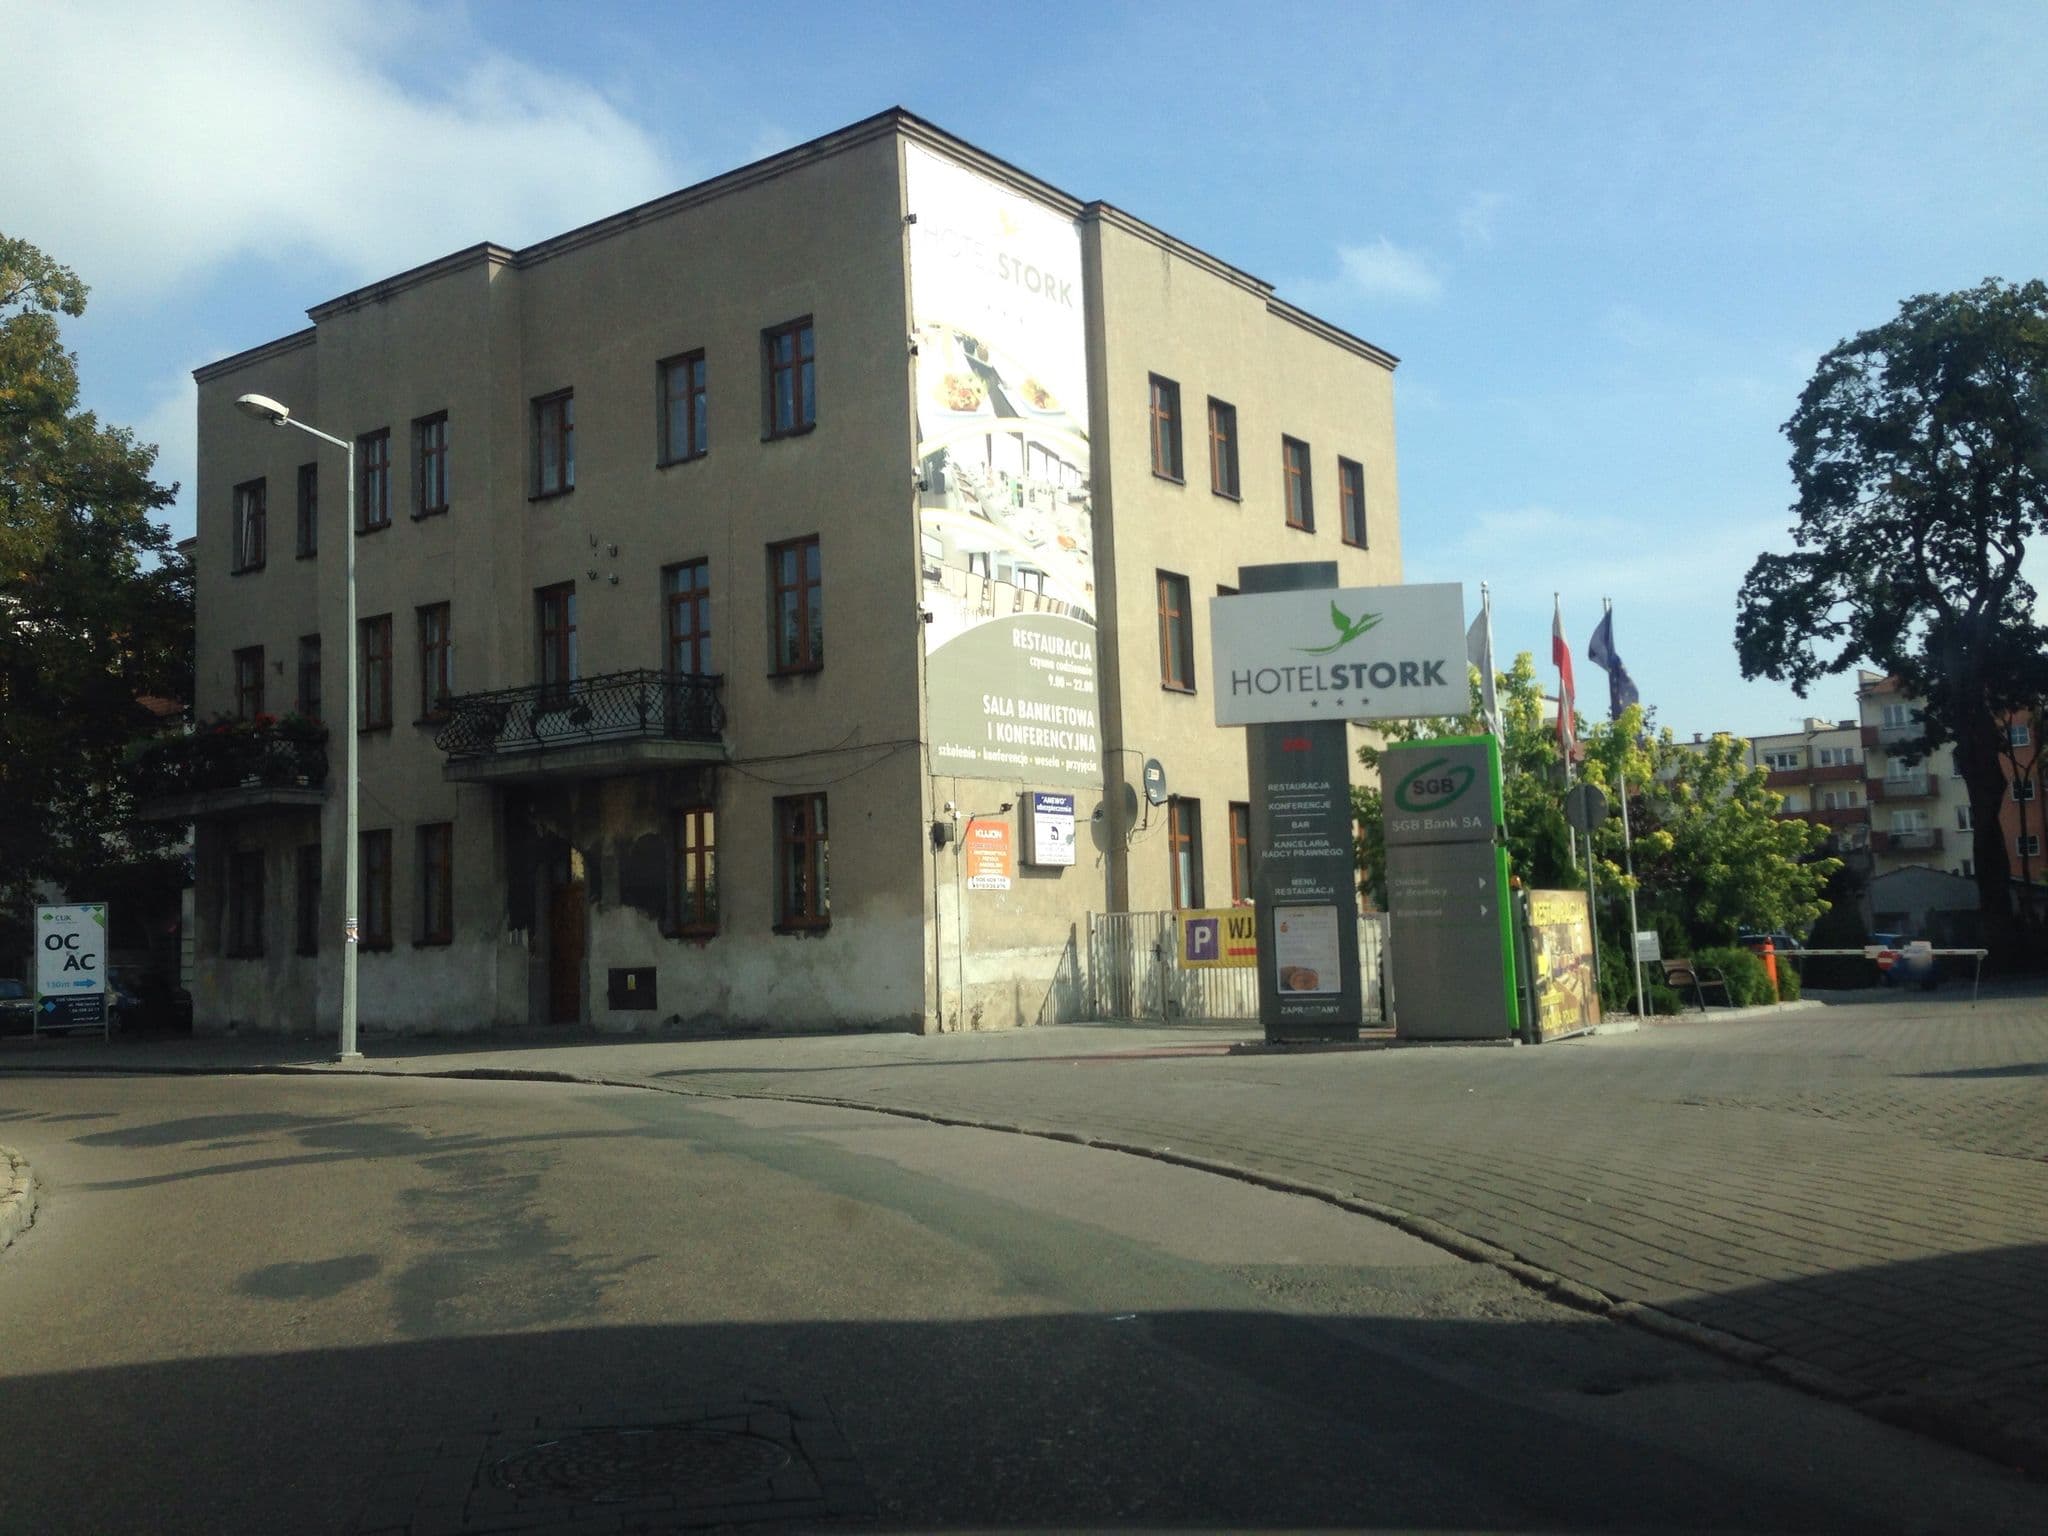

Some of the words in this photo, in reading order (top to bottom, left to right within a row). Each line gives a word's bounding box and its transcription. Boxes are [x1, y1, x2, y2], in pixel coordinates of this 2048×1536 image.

[998, 252, 1073, 308] STORK
[1012, 628, 1092, 661] RESTAURACJA
[982, 694, 1015, 717] SALA
[1018, 700, 1095, 728] BANKIETOWA
[988, 721, 992, 740] I
[996, 724, 1096, 753] KONFERENCYJNA
[983, 747, 1028, 766] konferencje
[1034, 755, 1060, 768] wesela
[1267, 782, 1330, 791] RESTAURACJA
[1413, 777, 1454, 795] SGB
[1268, 801, 1331, 811] KONFERENCJE
[1291, 821, 1310, 829] BAR
[1392, 819, 1419, 833] SGB
[1424, 817, 1457, 831] Bank
[1462, 816, 1482, 829] SA
[1273, 839, 1330, 848] KANCELARIA
[1262, 849, 1291, 858] RADCY
[1293, 848, 1344, 857] PRAWNEGO
[1274, 886, 1335, 896] RESTAURACJI
[1228, 917, 1257, 939] WJ
[45, 933, 80, 950] OC
[1194, 925, 1211, 953] P
[63, 953, 96, 971] AC
[1280, 1005, 1340, 1015] ZAPRAMY
